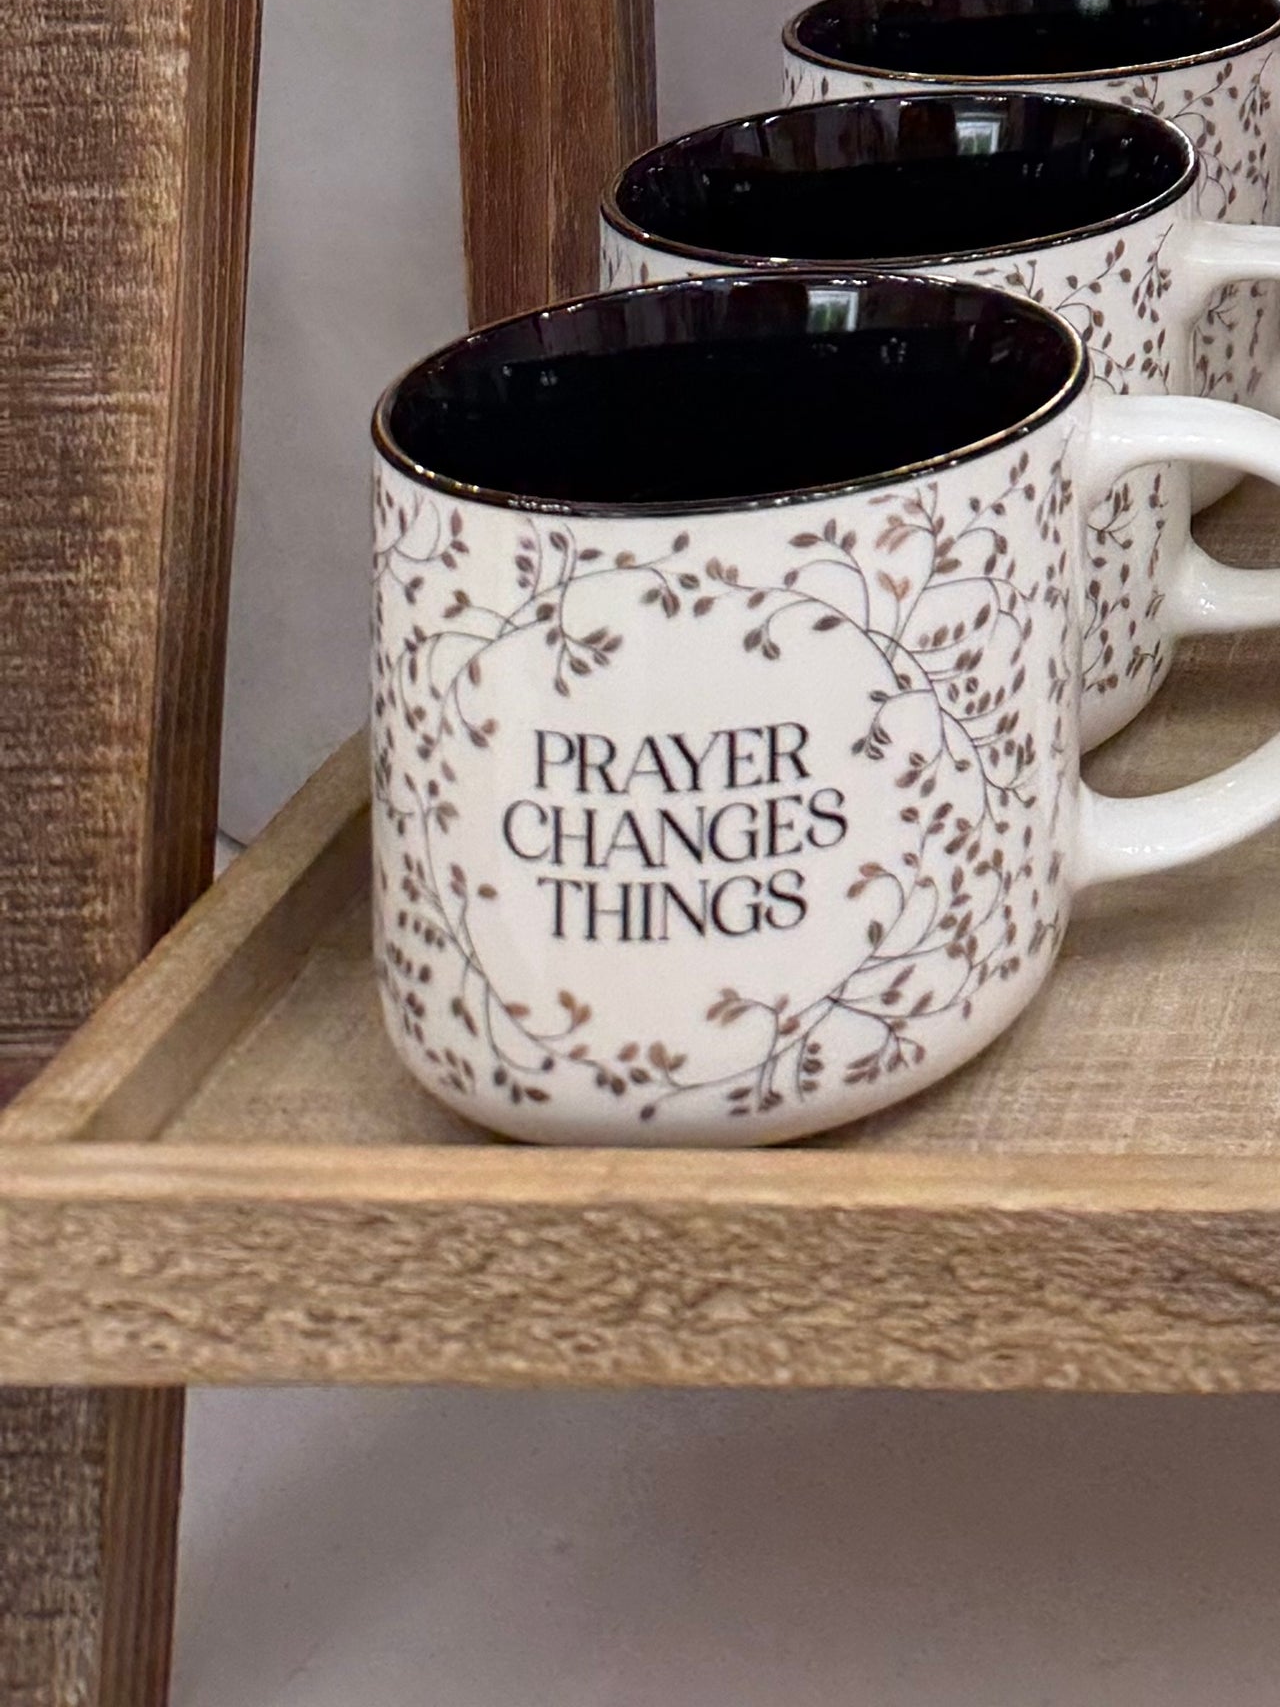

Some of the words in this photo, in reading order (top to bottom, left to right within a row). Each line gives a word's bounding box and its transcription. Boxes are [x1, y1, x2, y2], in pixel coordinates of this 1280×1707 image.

[534, 722, 812, 794] PRAYER
[503, 787, 849, 868] CHANGES
[538, 869, 809, 943] THINGS
